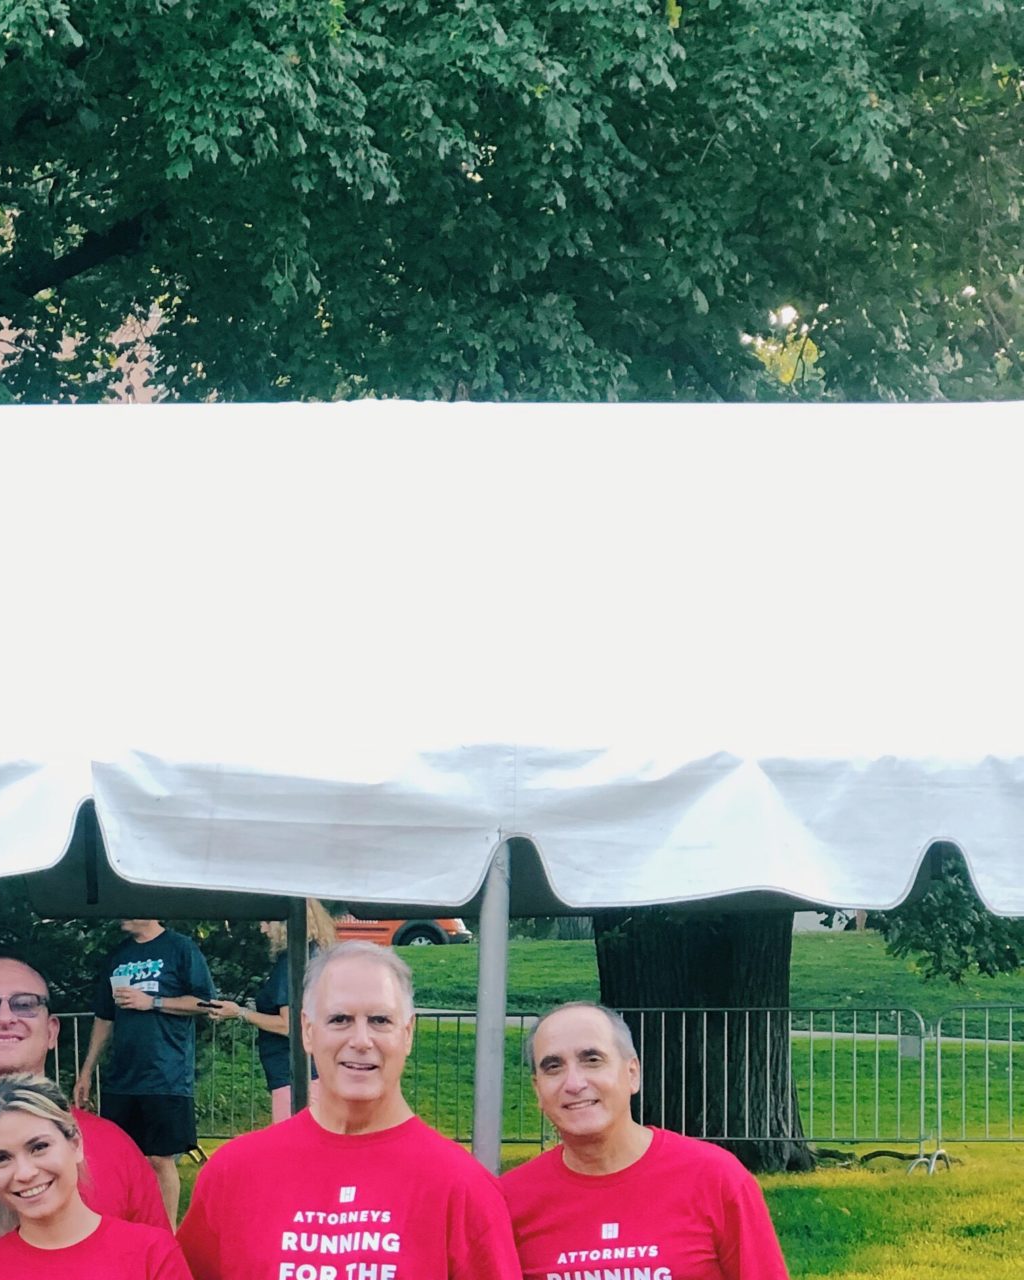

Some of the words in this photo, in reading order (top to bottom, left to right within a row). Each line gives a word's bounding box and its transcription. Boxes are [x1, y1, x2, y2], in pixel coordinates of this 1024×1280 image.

[294, 1211, 390, 1224] ATTORNEYS
[282, 1232, 400, 1254] RUNNING
[558, 1246, 658, 1264] ATTORNEYS
